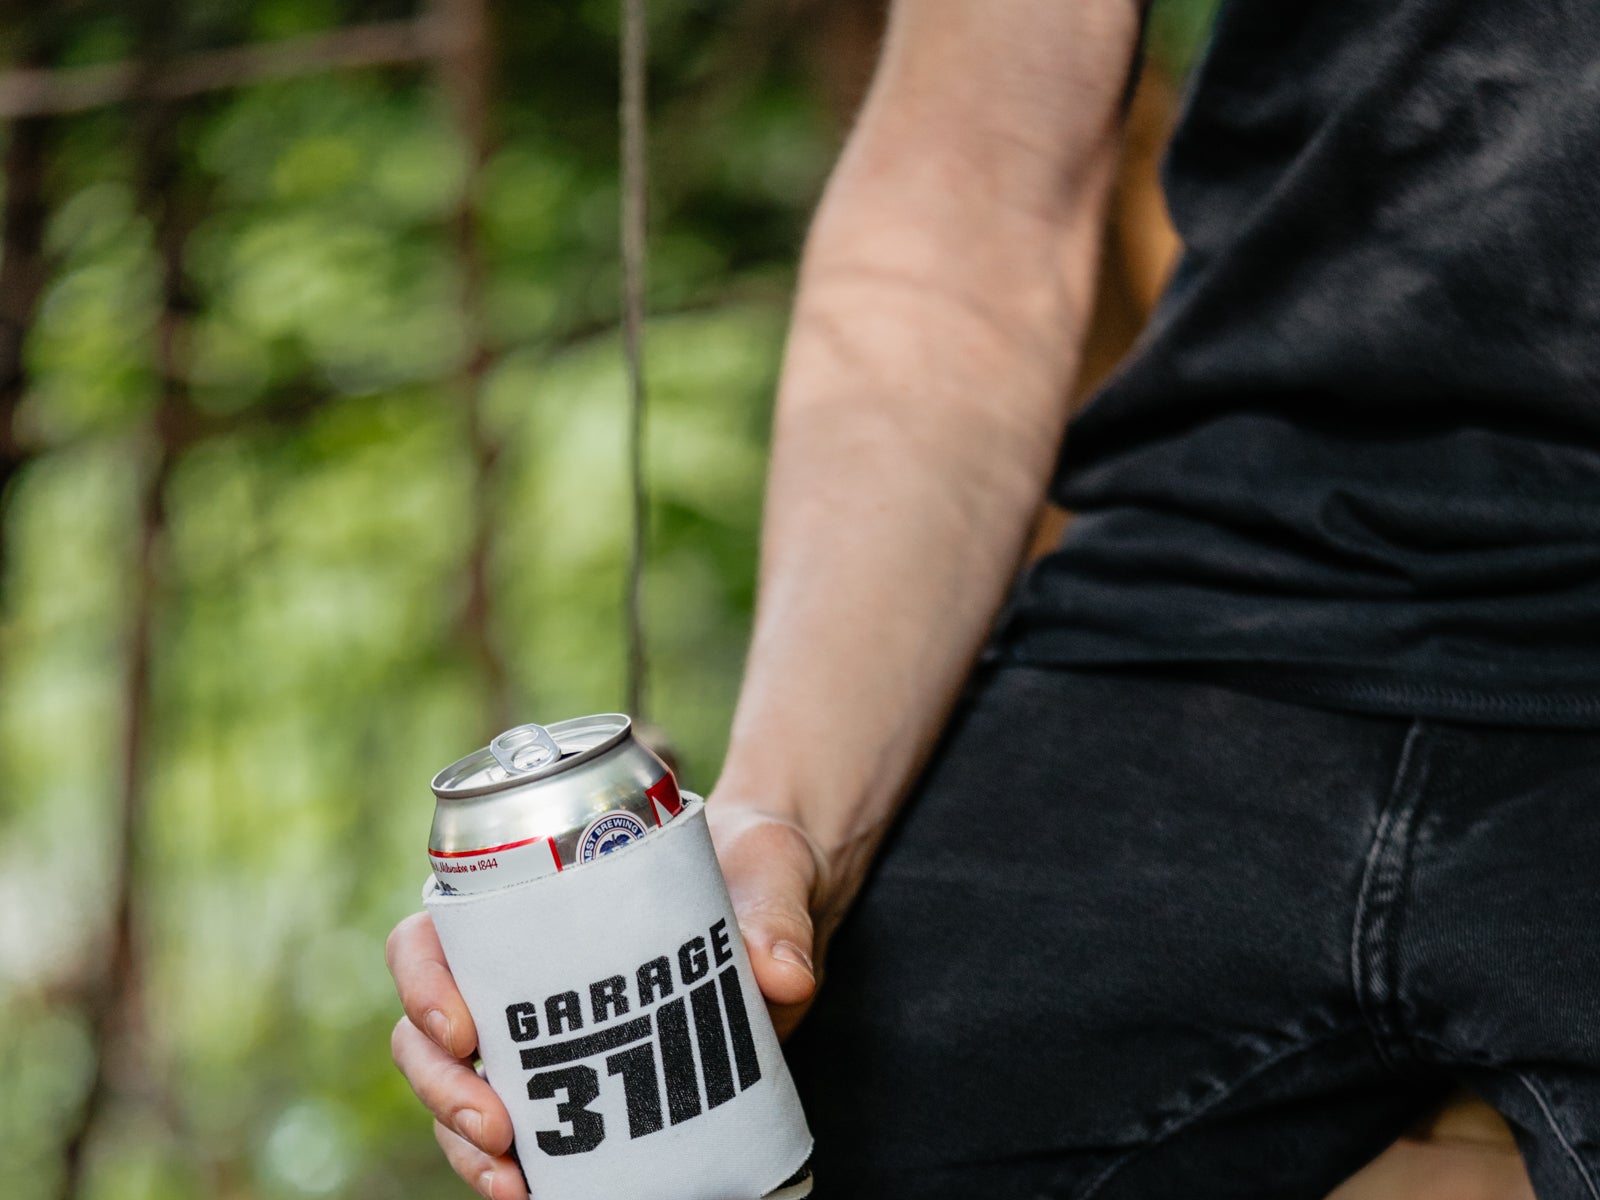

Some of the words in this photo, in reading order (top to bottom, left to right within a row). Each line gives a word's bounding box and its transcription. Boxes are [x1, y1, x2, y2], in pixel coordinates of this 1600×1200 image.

[595, 818, 639, 837] BREWING
[478, 858, 498, 871] 1844
[505, 917, 734, 1043] GARAGE
